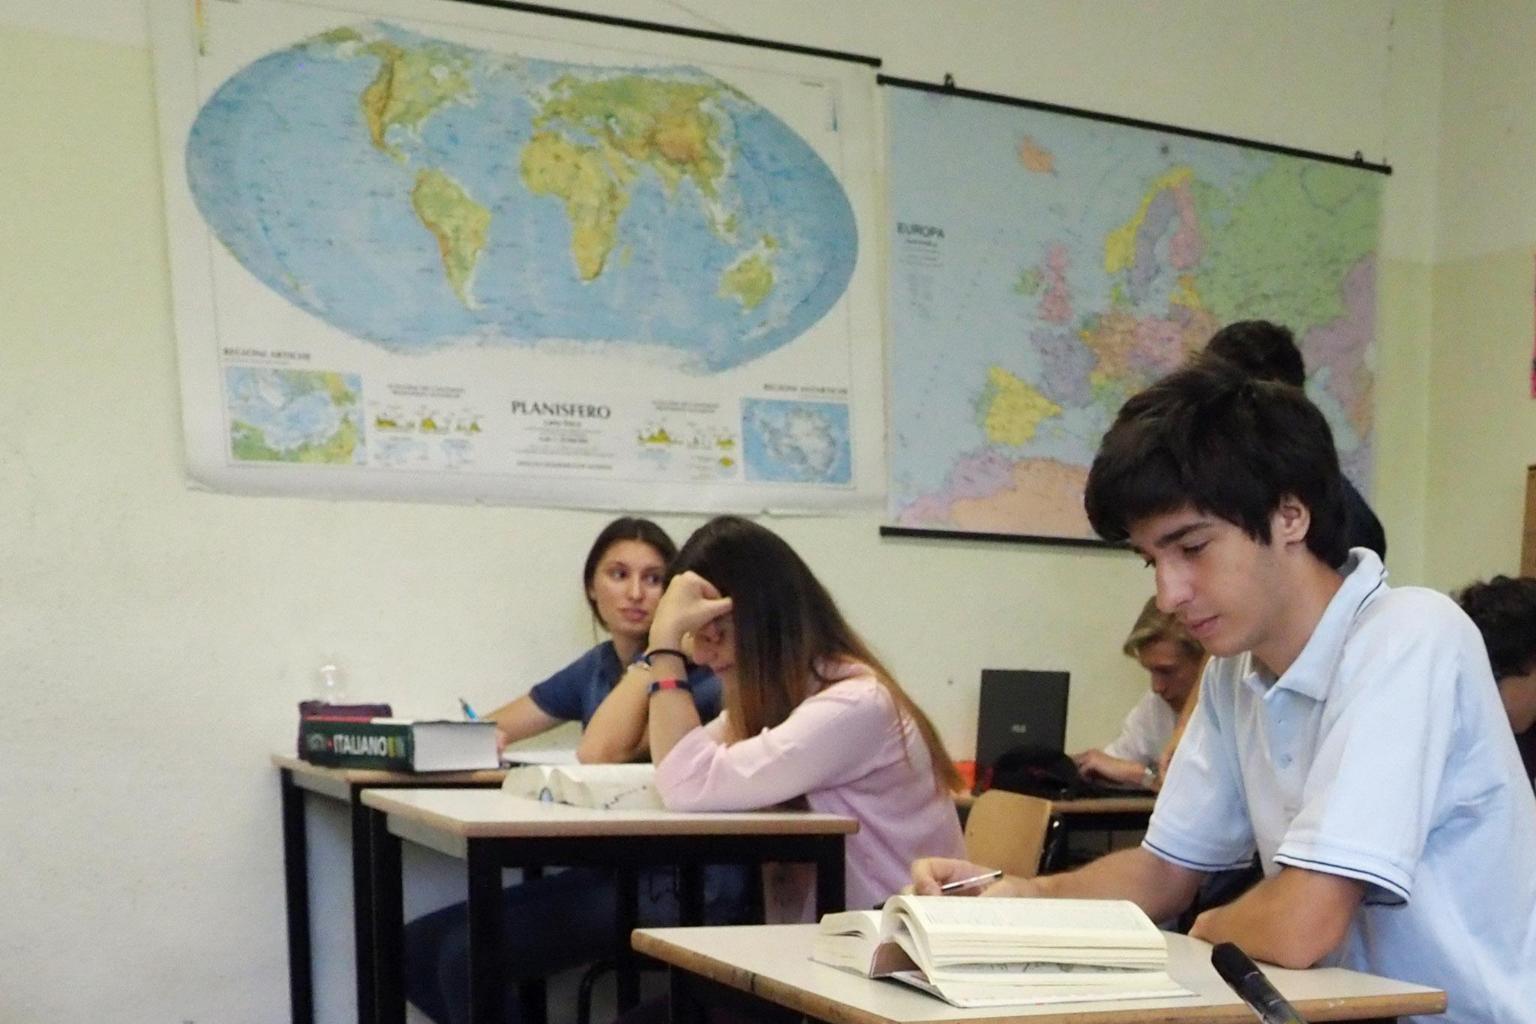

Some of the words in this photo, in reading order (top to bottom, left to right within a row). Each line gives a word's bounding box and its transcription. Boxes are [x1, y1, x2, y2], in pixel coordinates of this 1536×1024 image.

[896, 221, 945, 239] EUROPA
[511, 400, 611, 419] PLANISFERO
[333, 734, 387, 757] ITALIANO
